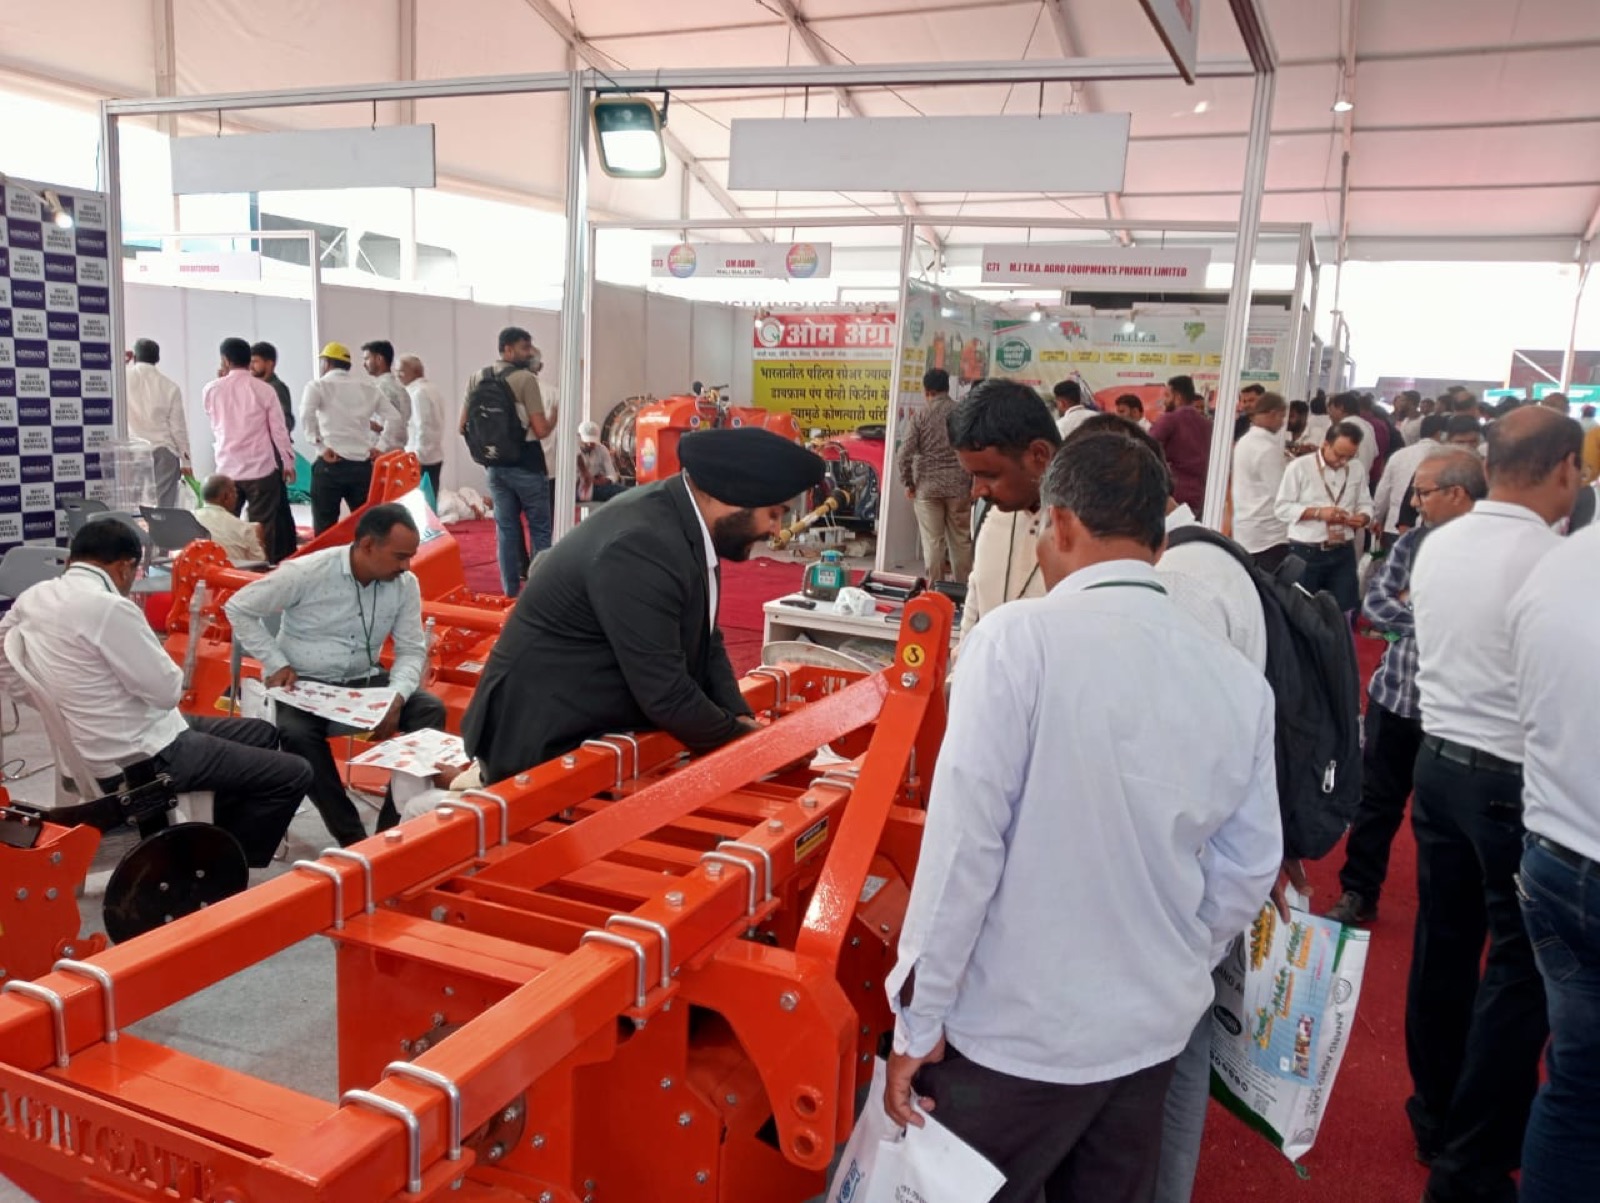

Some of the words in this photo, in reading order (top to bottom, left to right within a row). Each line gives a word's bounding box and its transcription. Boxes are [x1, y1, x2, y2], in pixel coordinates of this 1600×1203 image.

[1044, 264, 1065, 273] AGRO
[1067, 265, 1117, 275] EQUIPMENTS
[1119, 266, 1151, 276] PRIVATE
[1154, 266, 1187, 277] LIMITED
[786, 317, 836, 345] ओम
[807, 364, 834, 380] पहिला
